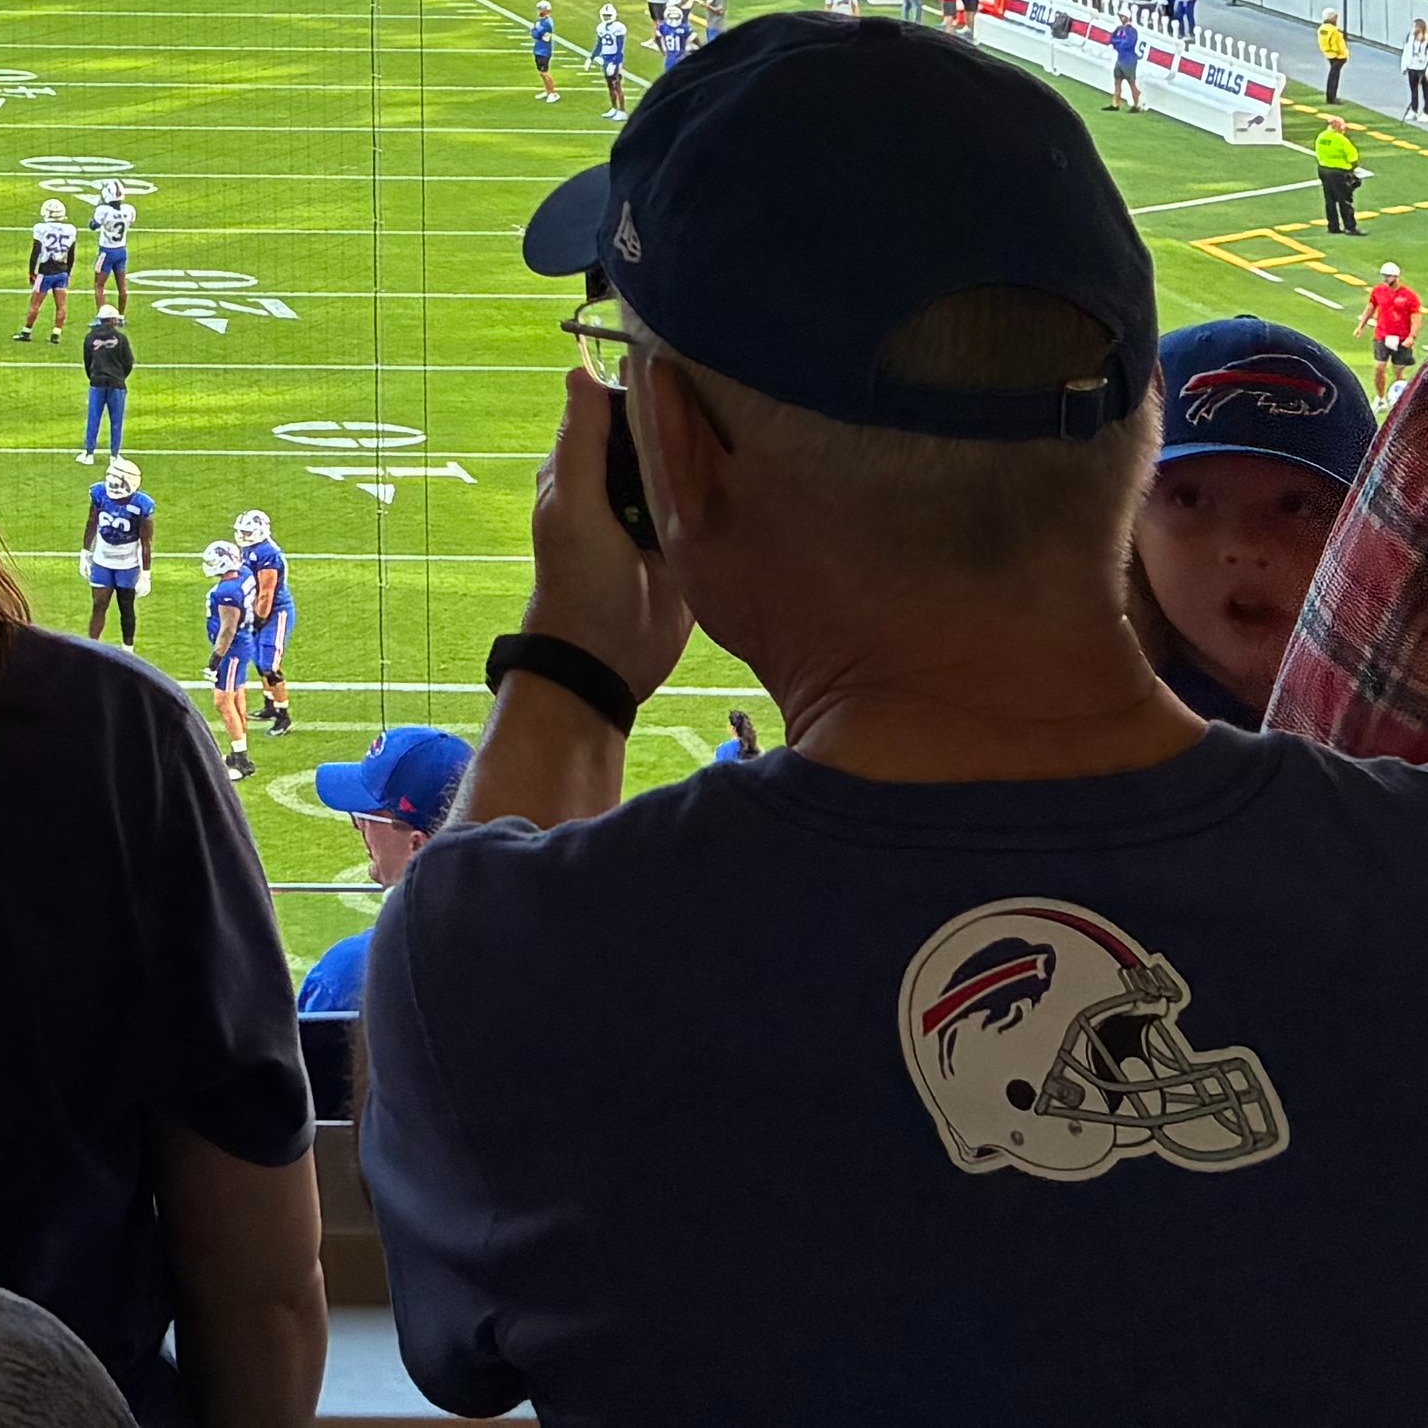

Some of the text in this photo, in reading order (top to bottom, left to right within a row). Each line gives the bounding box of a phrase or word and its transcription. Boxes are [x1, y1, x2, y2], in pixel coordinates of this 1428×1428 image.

[1204, 64, 1244, 95] BILLS
[111, 221, 126, 242] 3
[45, 233, 71, 254] 25
